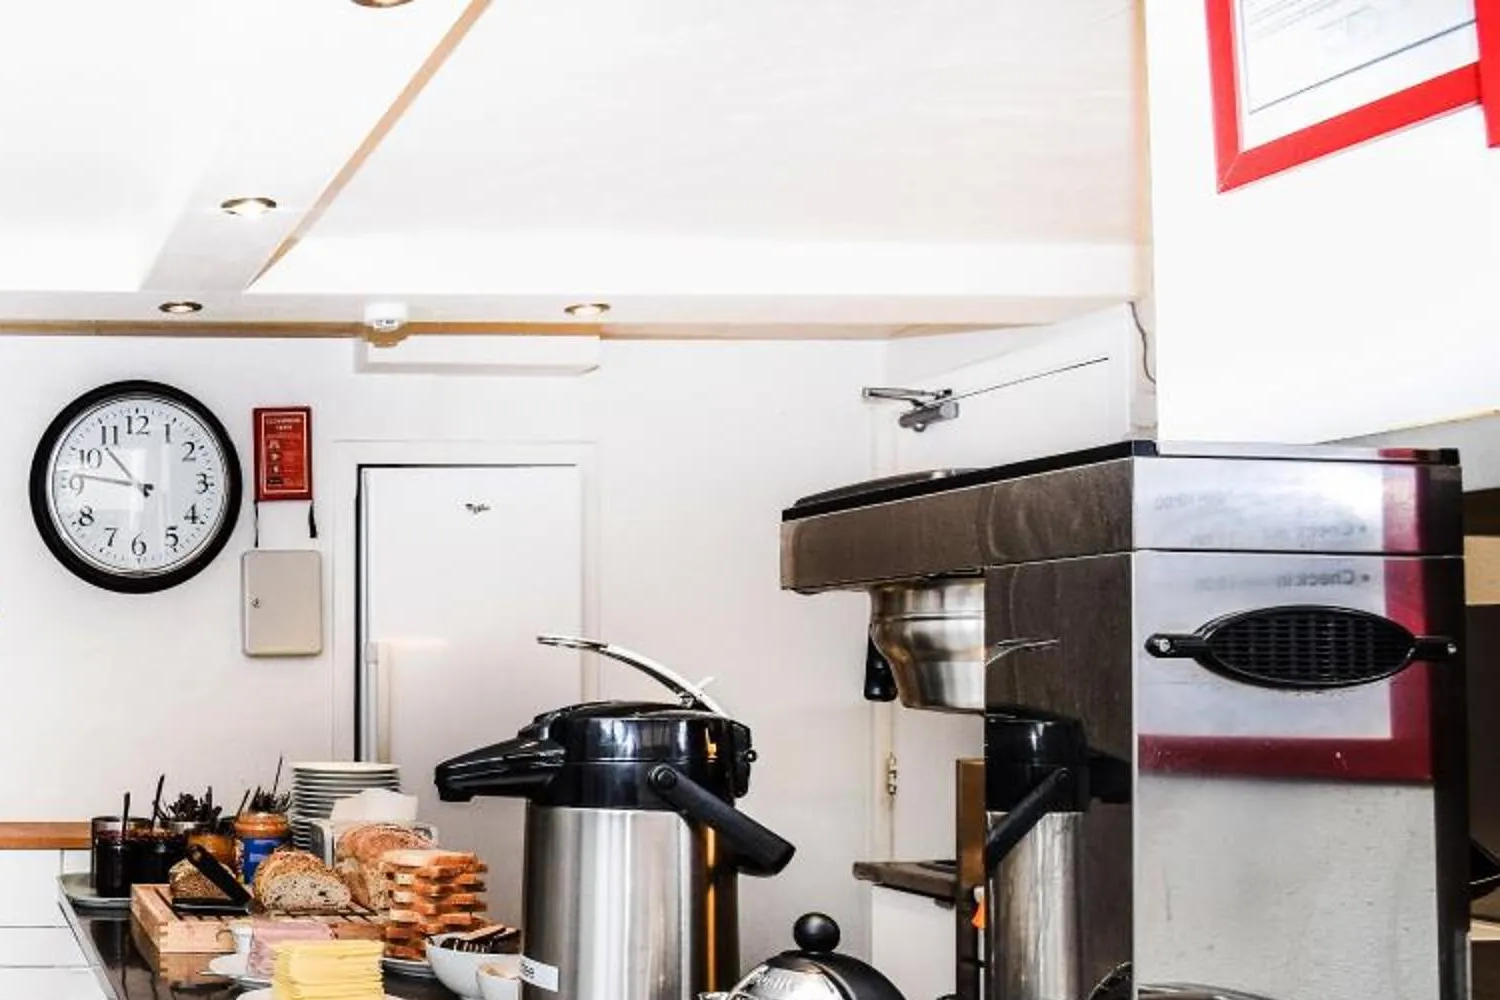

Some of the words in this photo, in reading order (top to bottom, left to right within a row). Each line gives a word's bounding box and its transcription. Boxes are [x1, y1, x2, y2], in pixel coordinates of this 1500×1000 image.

[101, 425, 119, 446] 11
[126, 415, 150, 436] 12
[164, 423, 171, 444] 1
[79, 448, 102, 470] 10
[182, 441, 197, 462] 2
[69, 473, 85, 497] 9
[196, 473, 209, 495] 3
[78, 505, 95, 527] 8
[184, 503, 200, 525] 4
[104, 527, 118, 548] 7
[131, 534, 147, 557] 6
[164, 526, 179, 549] 5
